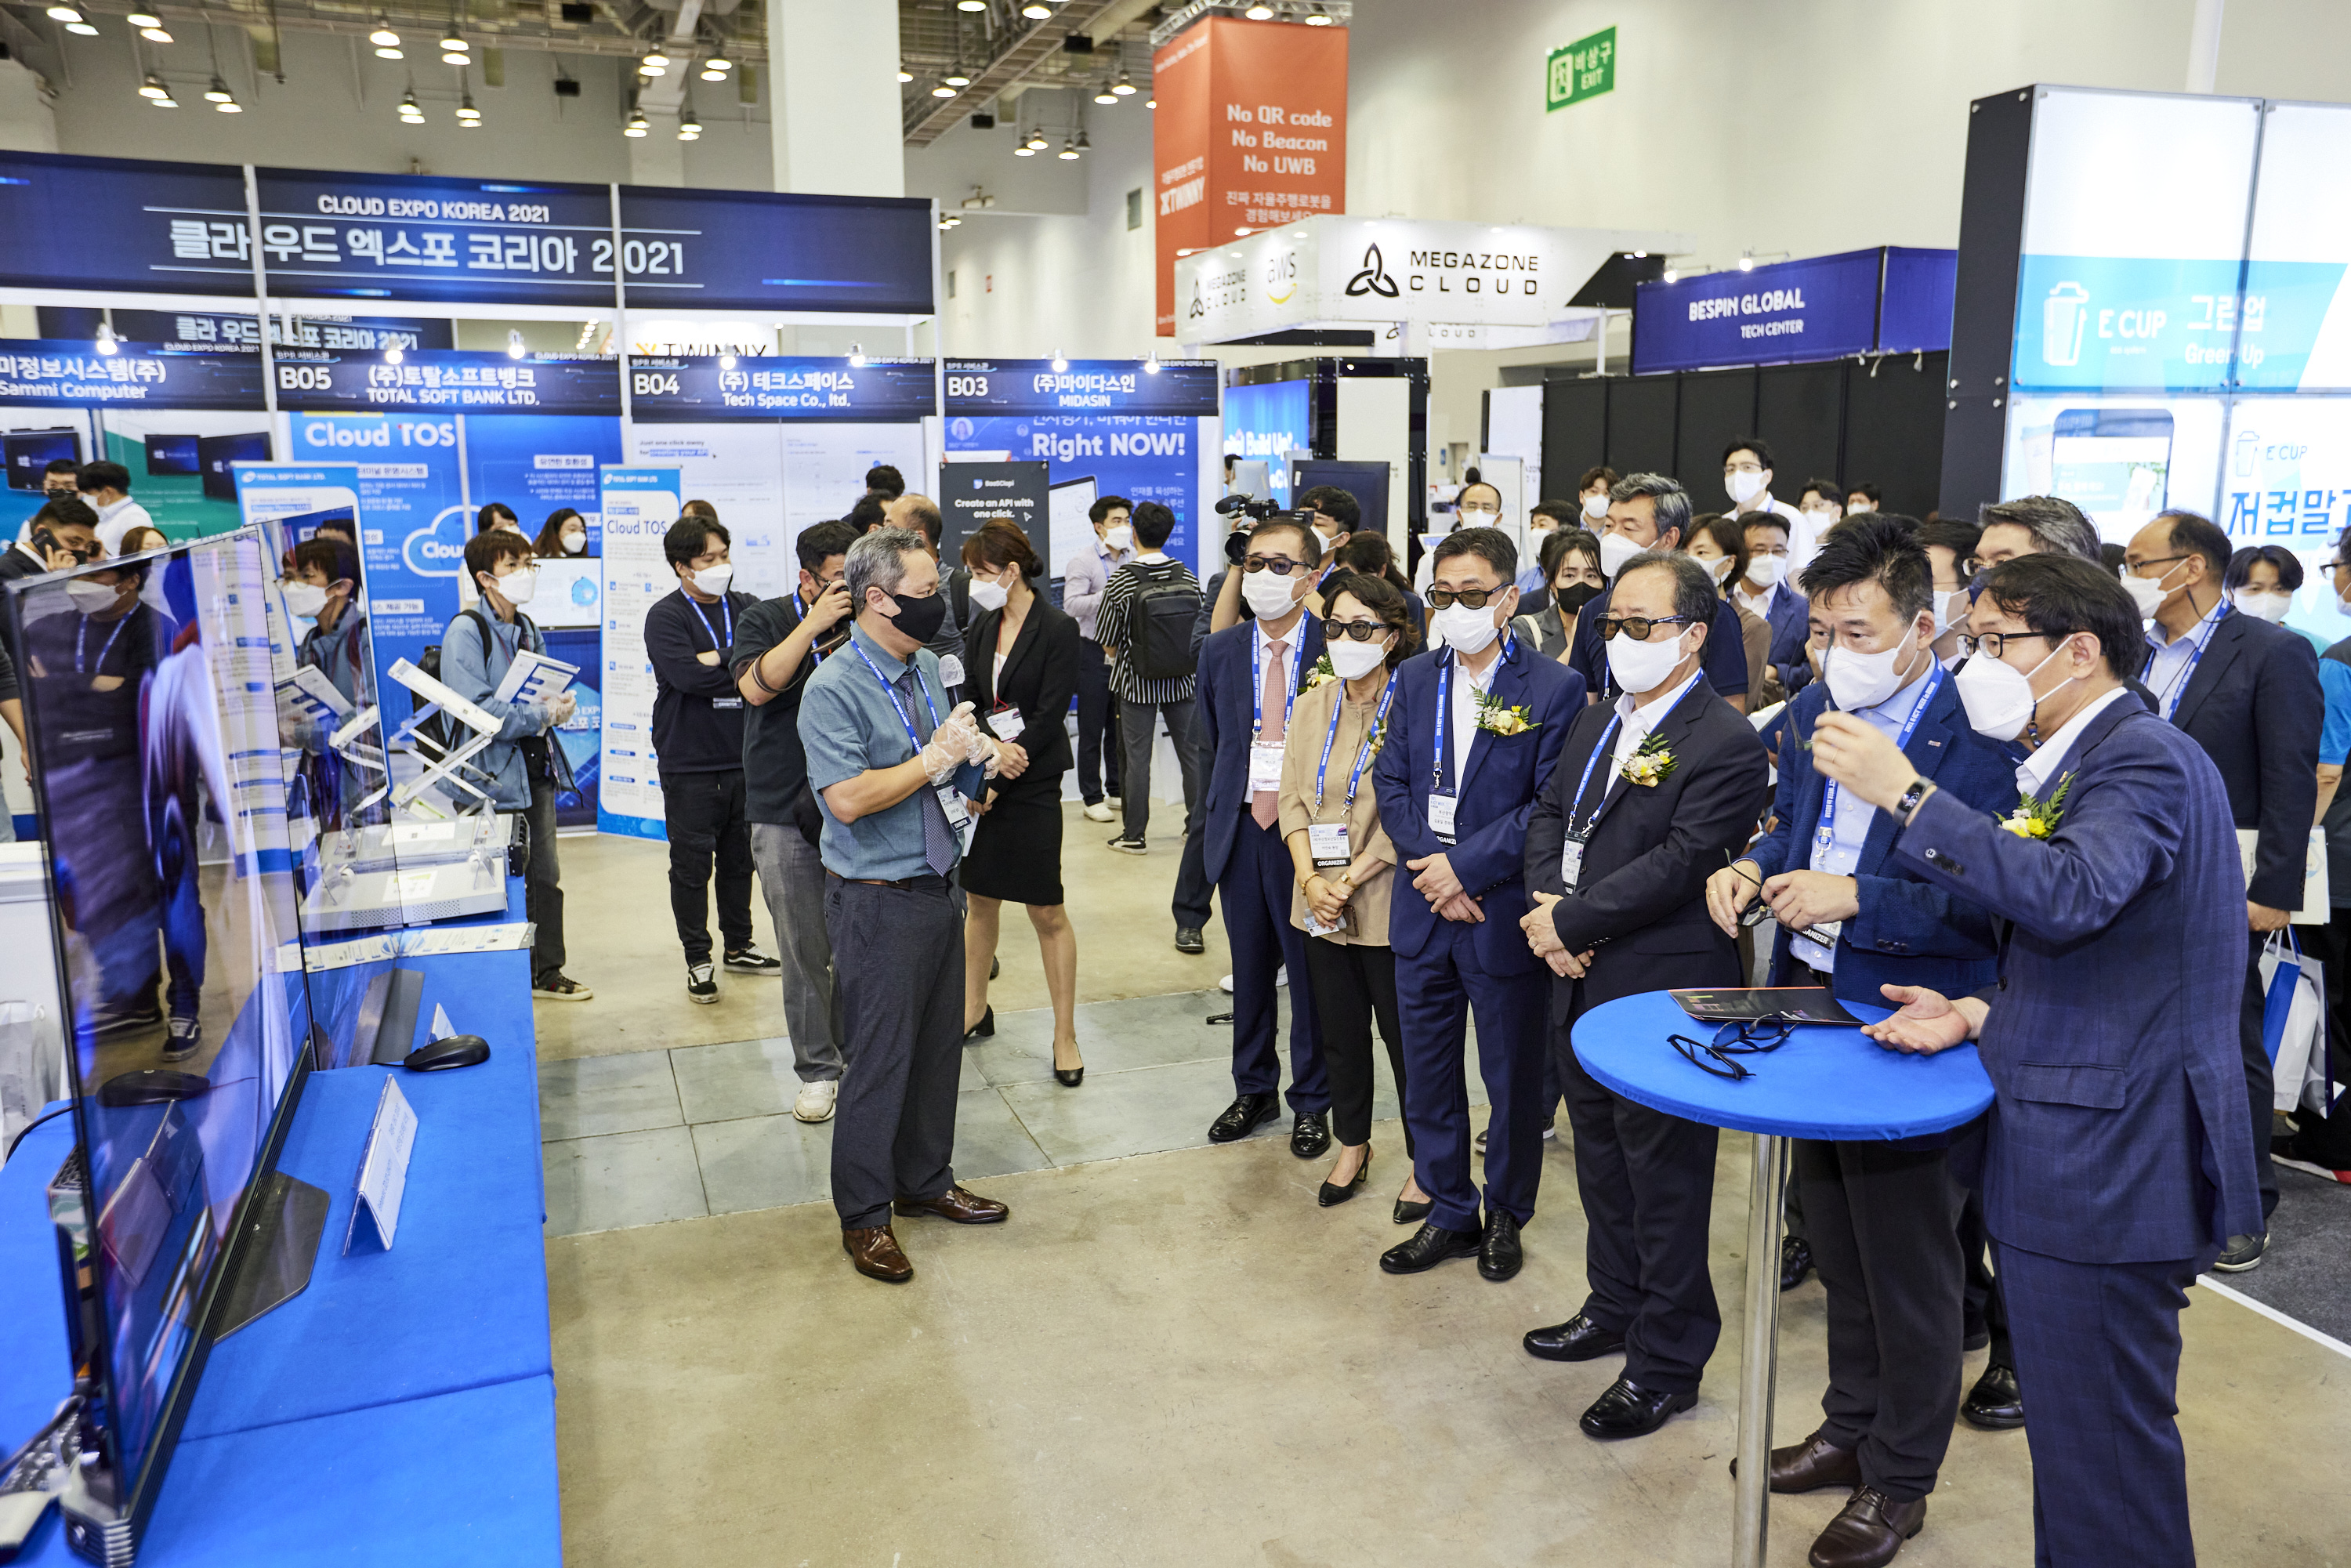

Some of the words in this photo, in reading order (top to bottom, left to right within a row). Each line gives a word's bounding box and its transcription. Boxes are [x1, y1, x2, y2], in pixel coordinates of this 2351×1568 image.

[1574, 42, 1612, 72] 비상구
[1581, 67, 1603, 90] EXIT
[1226, 104, 1252, 122] No
[1257, 106, 1285, 124] QR
[1290, 110, 1333, 128] code
[1232, 129, 1256, 147] No
[1263, 131, 1328, 151] Beacon
[1244, 155, 1268, 172] No
[1273, 156, 1316, 176] UWB
[318, 194, 384, 216] CLOUD
[389, 197, 437, 219] EXPO
[441, 199, 505, 222] KOREA
[508, 204, 549, 223] 2021
[347, 228, 458, 267] 엑스포
[468, 233, 578, 273] 코리아
[592, 241, 683, 275] 2021
[1411, 251, 1538, 271] MEGAZONE
[1268, 252, 1296, 284] aws
[1411, 275, 1538, 295] CLOUD
[1689, 296, 1739, 321] BESPIN
[1741, 288, 1806, 315] GLOBAL
[2186, 295, 2266, 332] 그린업
[1741, 324, 1764, 339] TECH
[1766, 319, 1803, 337] CENTER
[2099, 309, 2114, 339] E
[2118, 309, 2167, 339] CUP
[323, 327, 376, 350] 코리아
[2241, 343, 2265, 369] Up
[279, 366, 331, 390] B05
[368, 364, 537, 389] (주)토탈소프트뱅크
[634, 373, 679, 396] B04
[718, 371, 749, 393] (주)
[752, 371, 855, 393] 테크스페이스
[947, 376, 988, 397] B03
[1033, 373, 1136, 394] (주)마이다스인
[0, 380, 59, 397] Sammi
[61, 382, 149, 401] Computer
[366, 388, 417, 404] TOTAL
[420, 389, 460, 404] SOFT
[463, 389, 505, 406] BANK
[508, 390, 541, 406] LTD.
[723, 393, 755, 407] Tech
[758, 394, 798, 409] Space
[1059, 395, 1110, 407] MIDASIN
[305, 422, 390, 447] Cloud
[397, 422, 456, 447] TOS
[1032, 433, 1103, 462] Right
[1110, 433, 1186, 457] NOW!
[2266, 445, 2276, 461] E
[2279, 445, 2308, 461] CUP
[955, 499, 985, 508] Create
[998, 498, 1013, 508] API
[1014, 498, 1034, 508] with
[991, 509, 1015, 519] click.
[607, 520, 639, 534] Cloud
[644, 520, 667, 534] TOS
[422, 541, 465, 559] Clou
[1436, 836, 1456, 845] GANIZ
[1802, 929, 1830, 944] ANIZER
